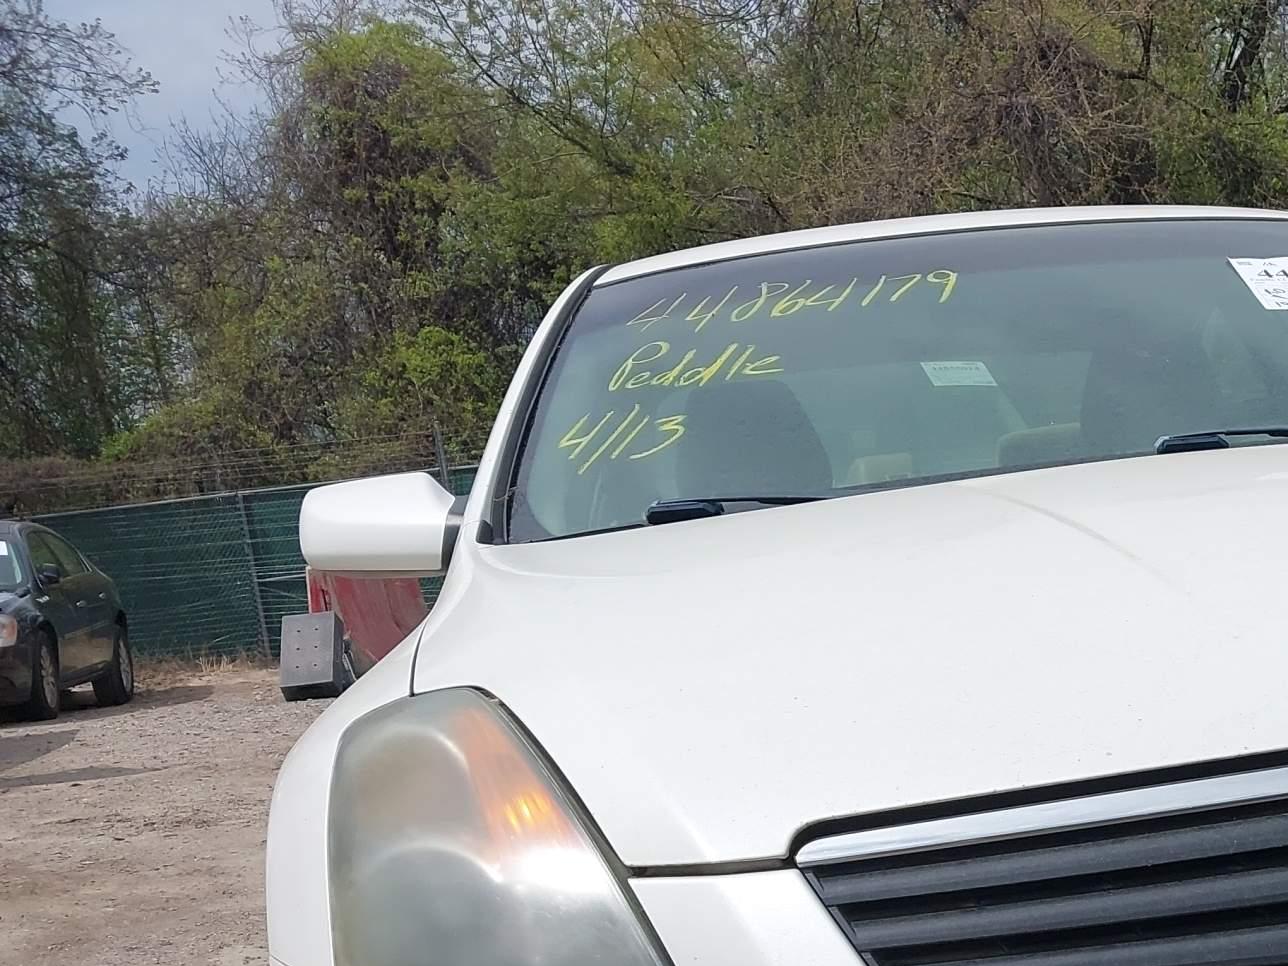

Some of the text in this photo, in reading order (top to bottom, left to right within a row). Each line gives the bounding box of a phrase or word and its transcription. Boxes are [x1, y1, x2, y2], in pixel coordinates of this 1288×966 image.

[626, 269, 959, 333] 44864179
[608, 340, 784, 392] Peddle
[557, 403, 688, 476] 4/13
